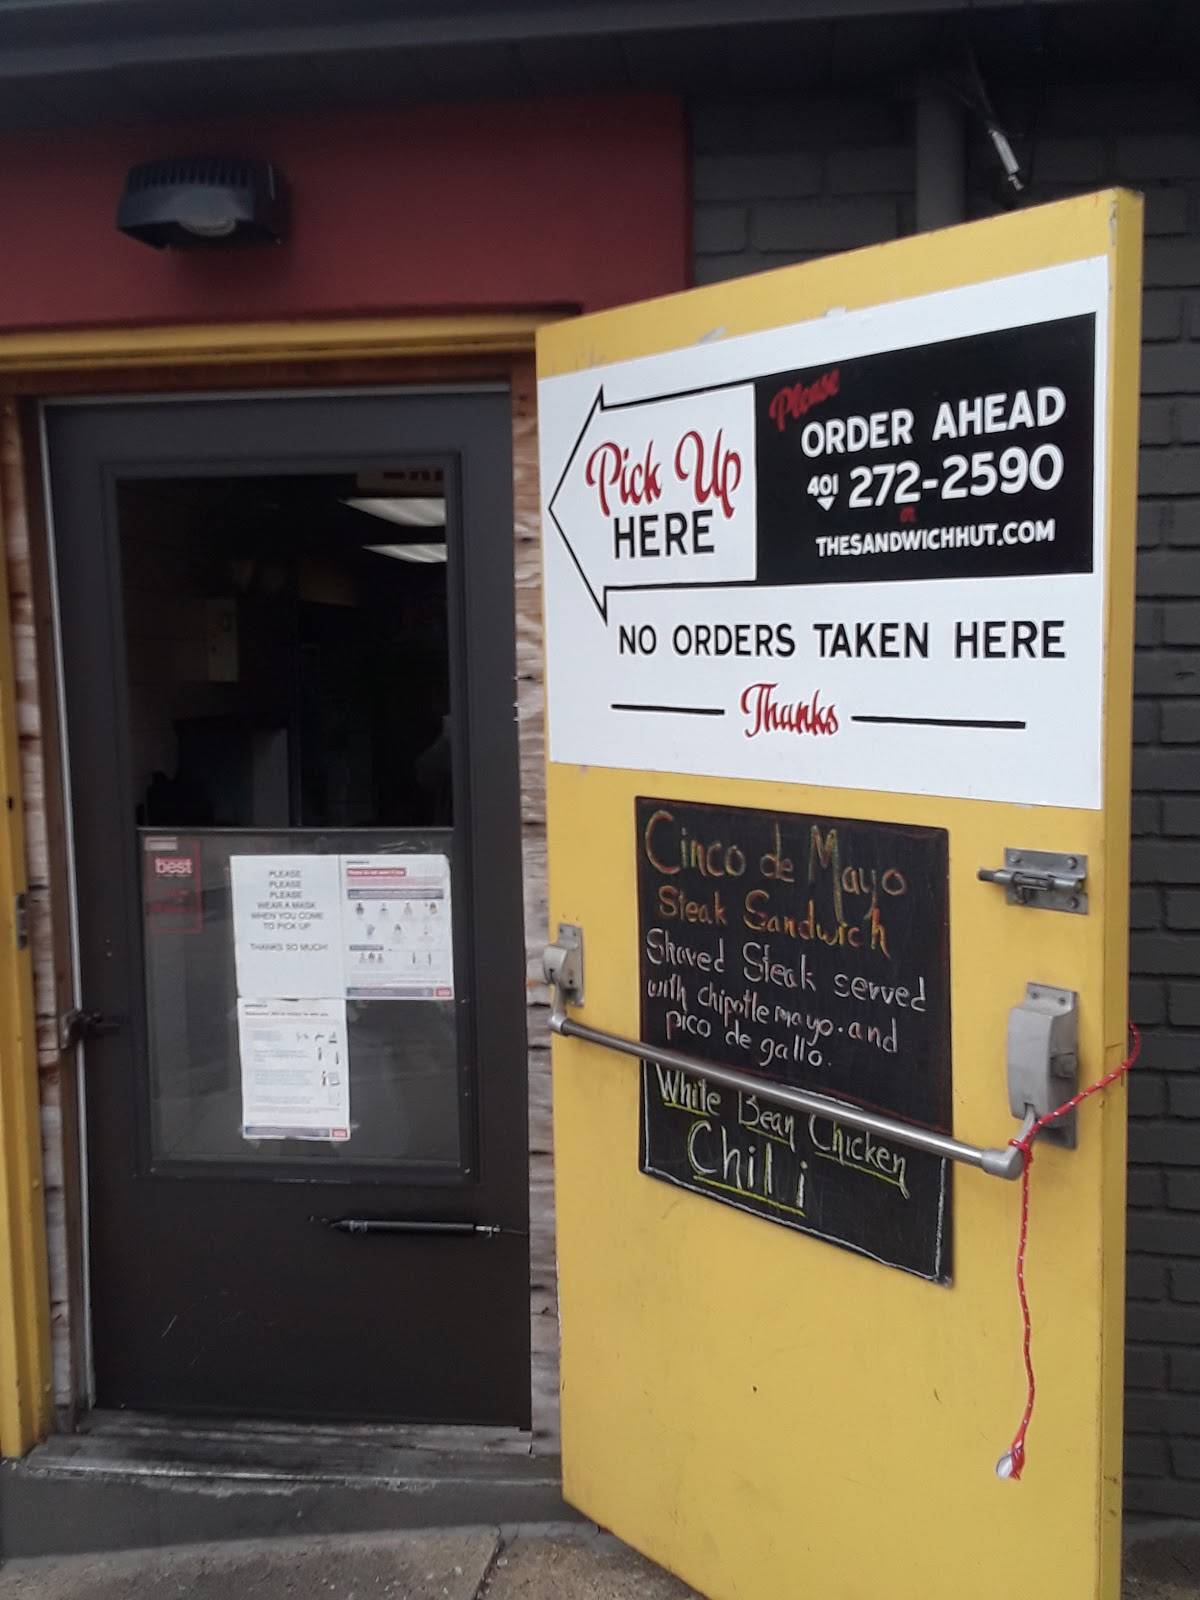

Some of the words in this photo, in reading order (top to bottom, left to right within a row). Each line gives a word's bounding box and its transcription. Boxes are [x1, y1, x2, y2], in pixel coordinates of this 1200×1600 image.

[801, 408, 915, 458] ORDER
[931, 386, 1067, 441] AHEAD
[585, 440, 662, 518] Pick
[674, 428, 742, 519] Up
[807, 473, 839, 496] 401
[848, 443, 1065, 509] 272-2590
[613, 509, 715, 560] HERE
[815, 518, 1056, 557] THESANDWICHHUT.COM
[619, 624, 657, 655] NO
[672, 623, 796, 656] ORDERS
[812, 621, 929, 659] TAKEN
[954, 620, 1066, 659] HERE
[740, 682, 839, 738] Thanks
[268, 870, 302, 878] PLEASE
[268, 881, 302, 889] PLEASE
[269, 891, 303, 899] PLEASE
[645, 810, 746, 877] Cinco
[760, 820, 795, 883] de
[808, 825, 907, 926] Mayo
[250, 912, 277, 920] WHEN
[279, 912, 297, 920] YOU
[298, 912, 324, 920] COME
[263, 922, 275, 930] TO
[658, 885, 727, 927] Steak
[743, 889, 892, 960] Sandwich
[646, 928, 726, 974] Shaved
[743, 942, 817, 993] Steak
[834, 971, 927, 1013] served
[648, 973, 687, 1012] with
[698, 982, 770, 1028] chipotle
[666, 1010, 712, 1041] pico
[725, 1020, 751, 1049] de
[656, 1064, 722, 1117] White
[738, 1090, 796, 1152] Bean
[808, 1112, 910, 1201] Chicken
[687, 1120, 809, 1209] Chili
